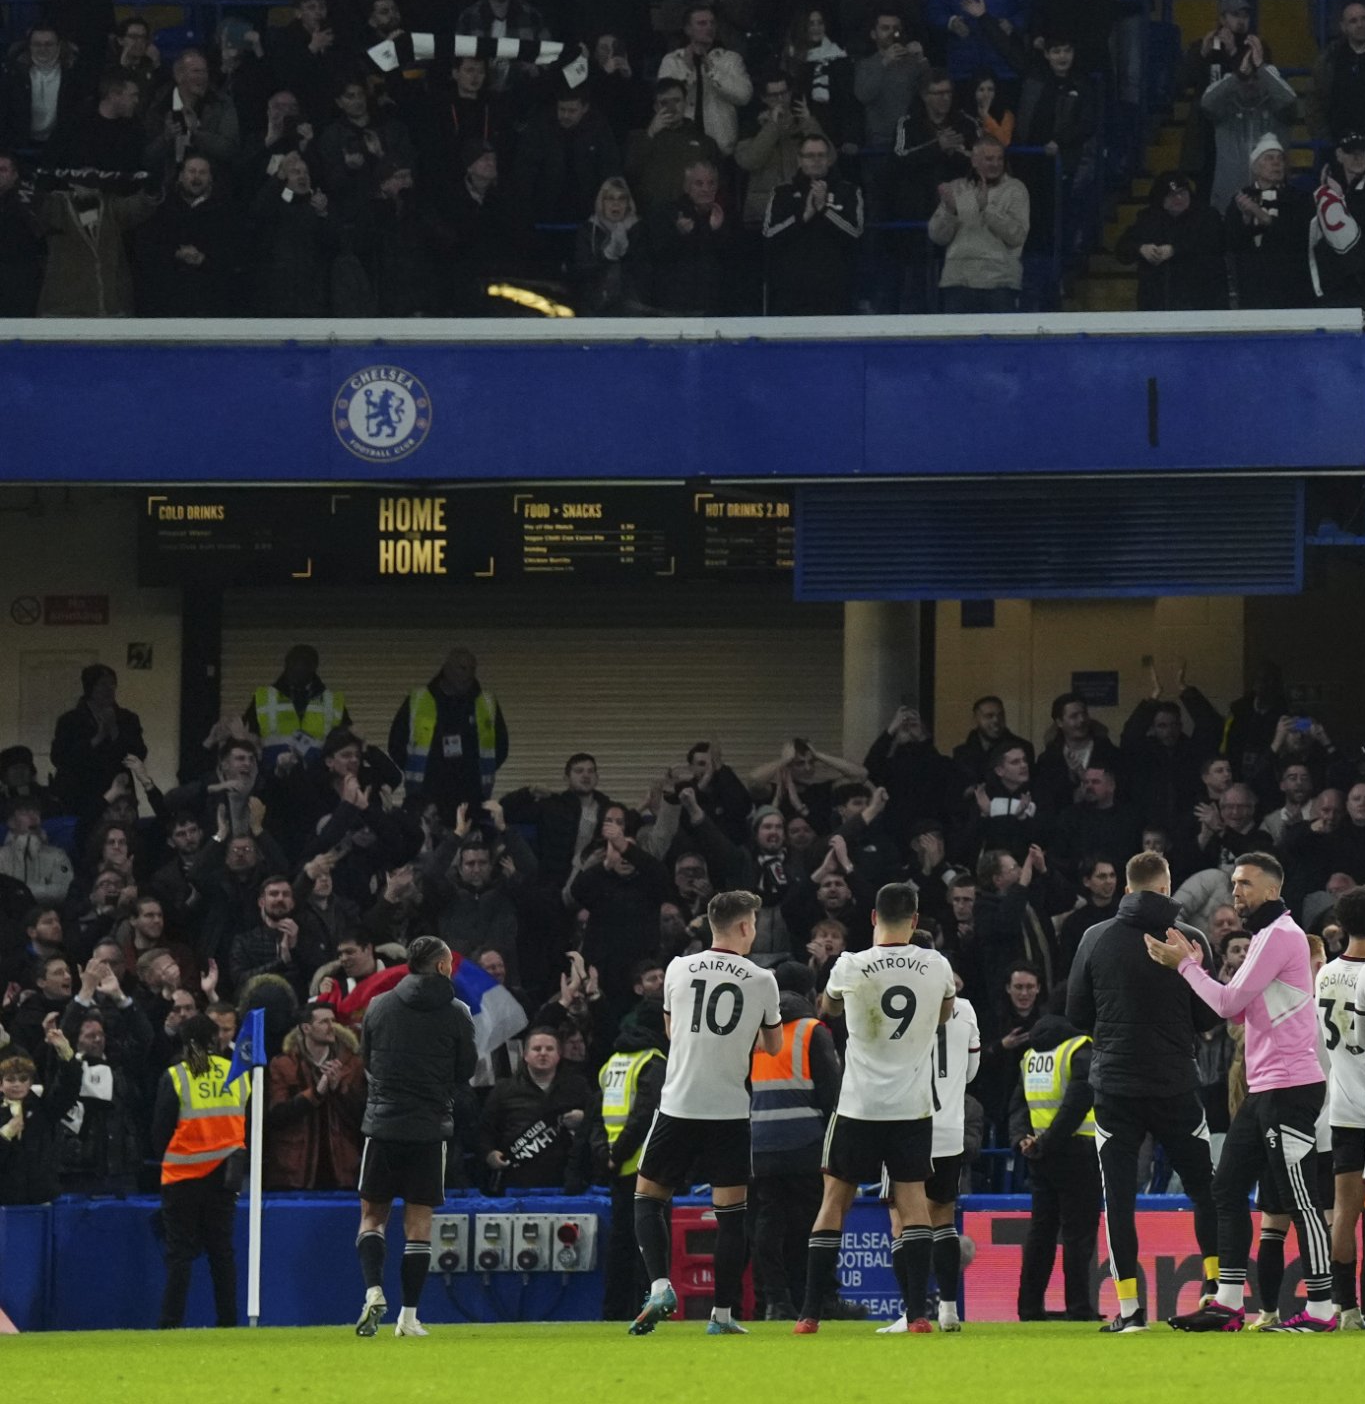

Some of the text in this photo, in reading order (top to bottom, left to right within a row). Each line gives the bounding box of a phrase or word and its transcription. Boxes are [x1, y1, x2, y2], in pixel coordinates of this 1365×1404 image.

[350, 367, 415, 391] CHELSEA
[349, 438, 416, 458] FOOTBALL CLUB
[158, 505, 224, 520] COLD DRINKS
[378, 497, 447, 532] HOME
[524, 503, 550, 518] FOOD
[562, 503, 602, 518] SNACKS
[705, 502, 725, 518] HOT
[727, 502, 764, 518] DRINKS
[378, 539, 447, 574] HOME
[688, 959, 753, 982] CAIRNEY
[1319, 972, 1357, 993] ROBINS
[690, 979, 745, 1036] 10
[880, 984, 917, 1040] 9
[1027, 1055, 1054, 1073] 600
[198, 1082, 233, 1099] SIA
[840, 1232, 891, 1250] ELSEA
[836, 1251, 893, 1269] OTBAL
[841, 1270, 863, 1287] UB
